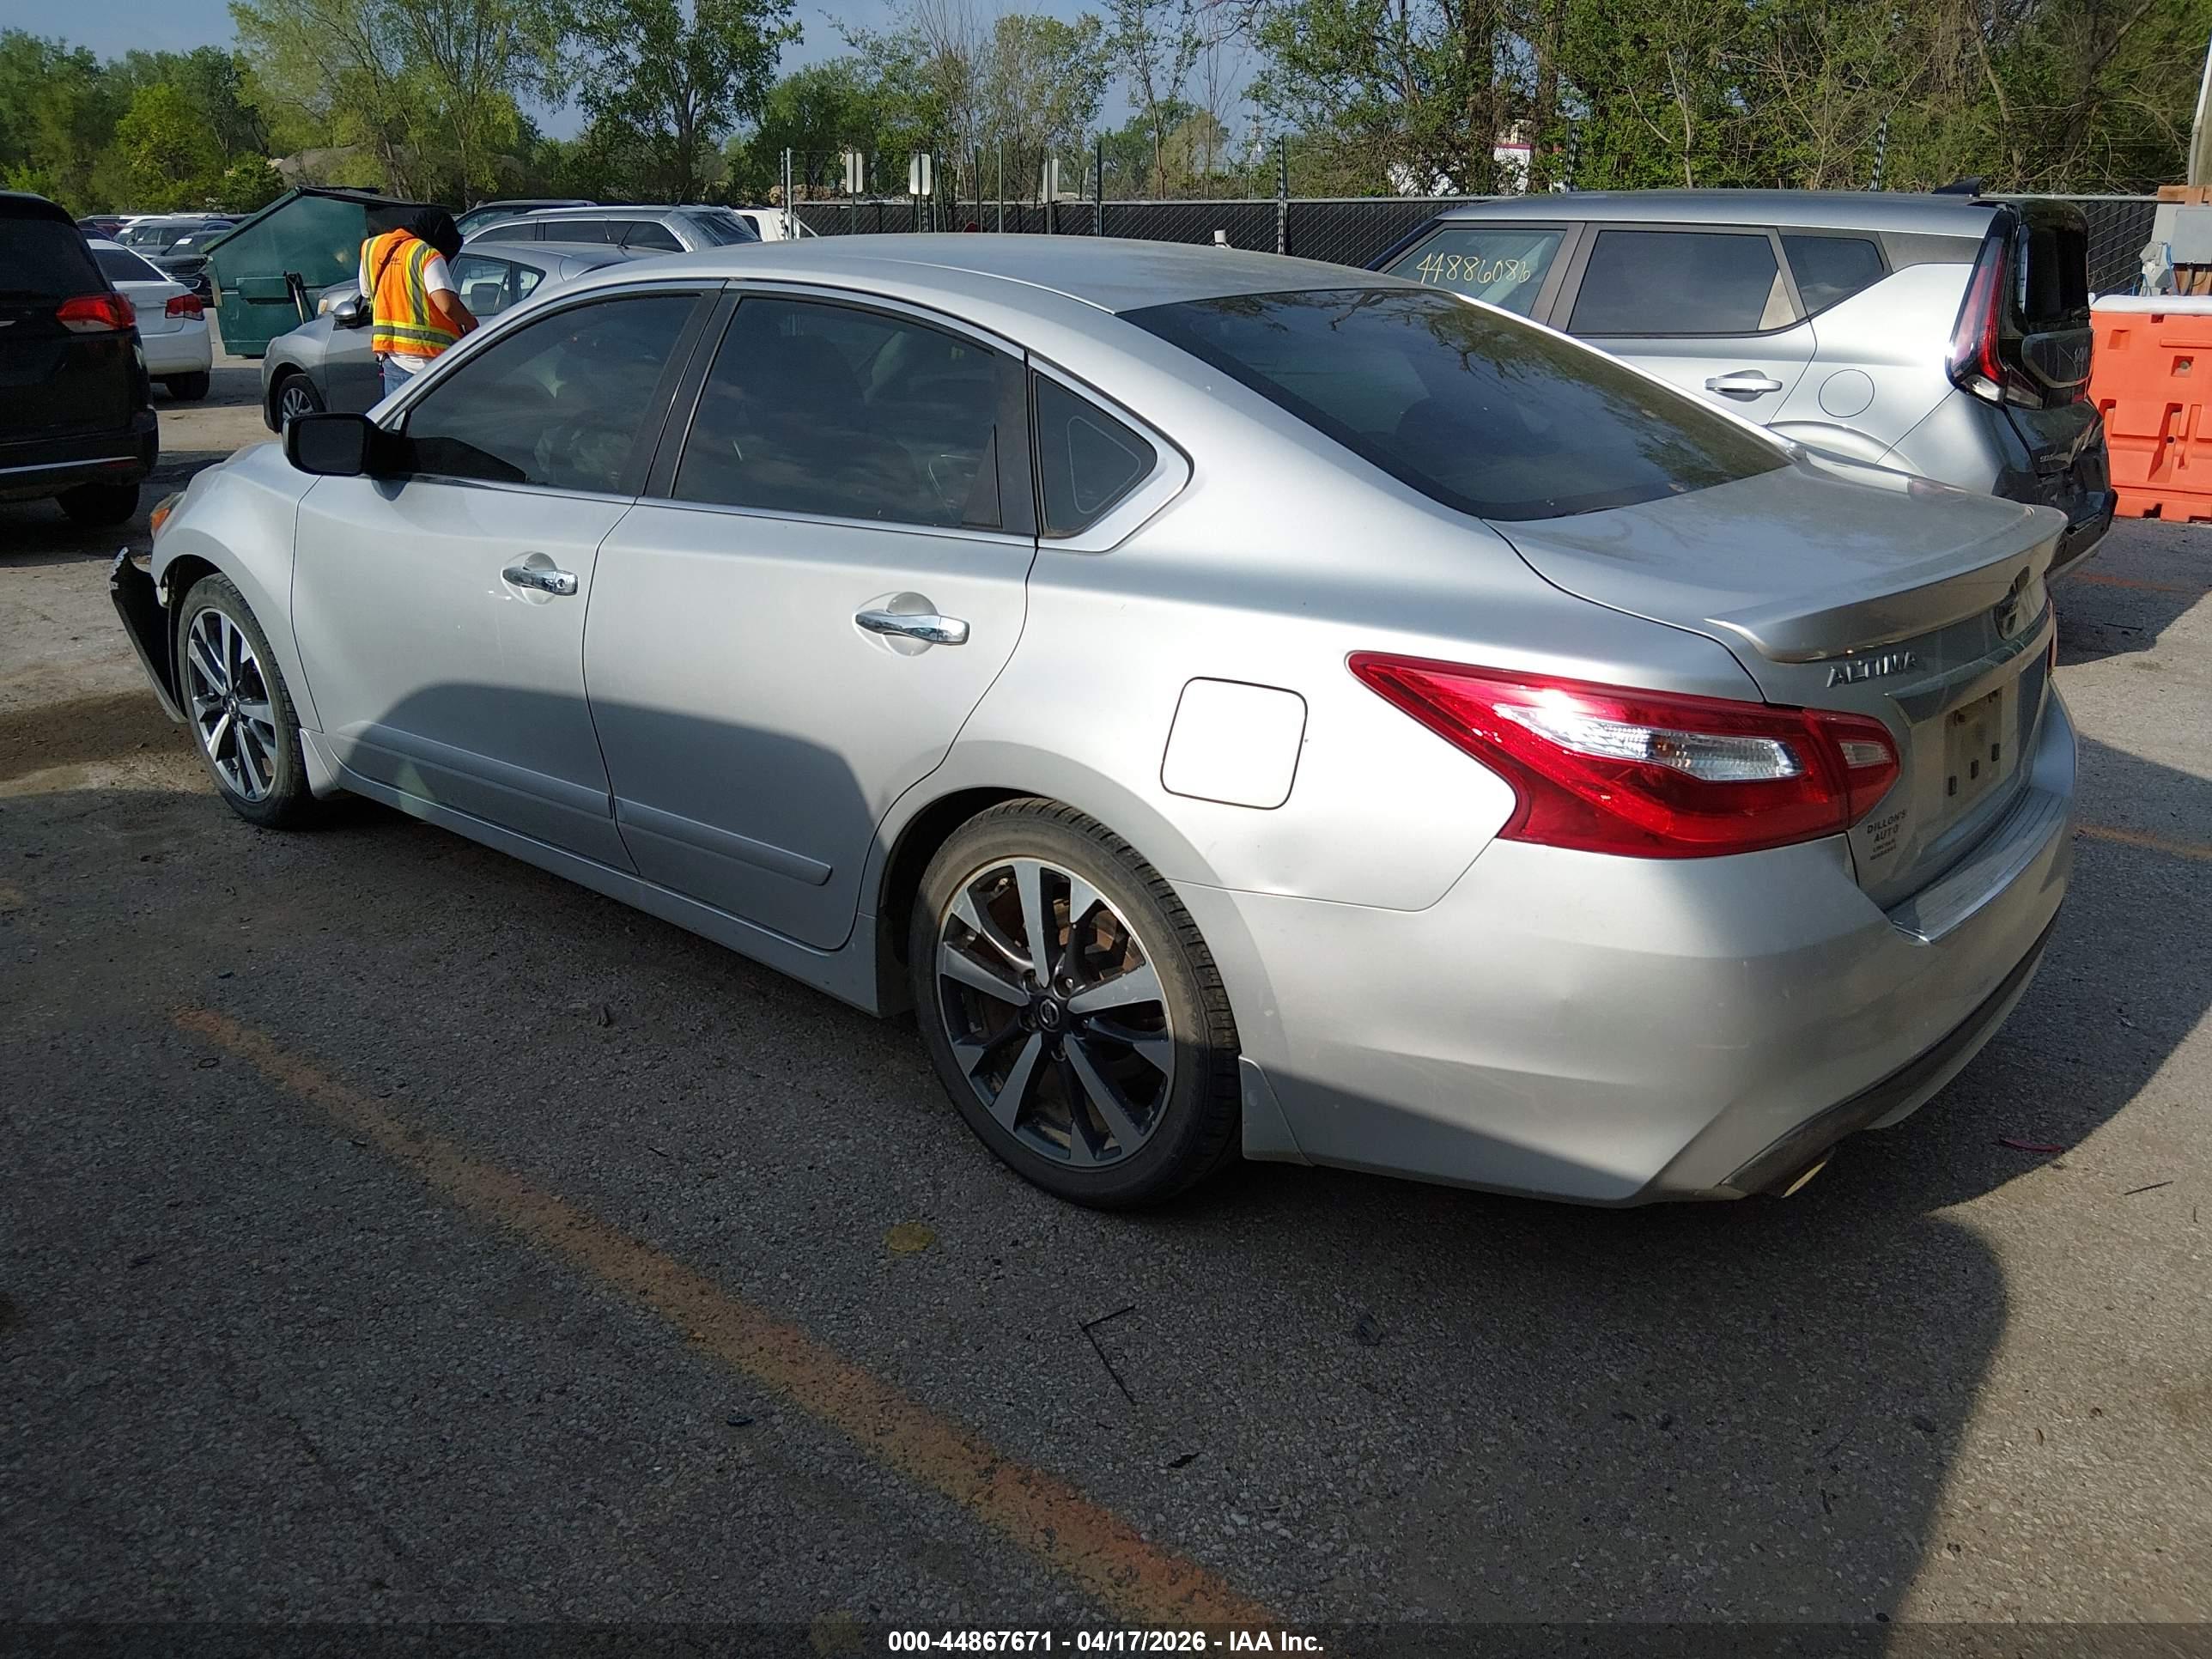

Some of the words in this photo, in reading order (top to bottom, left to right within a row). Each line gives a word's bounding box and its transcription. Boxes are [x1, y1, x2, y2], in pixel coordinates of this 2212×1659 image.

[1416, 252, 1531, 284] 44886086
[1826, 652, 1917, 688] ALTIMA
[1874, 823, 1899, 843] AUTO
